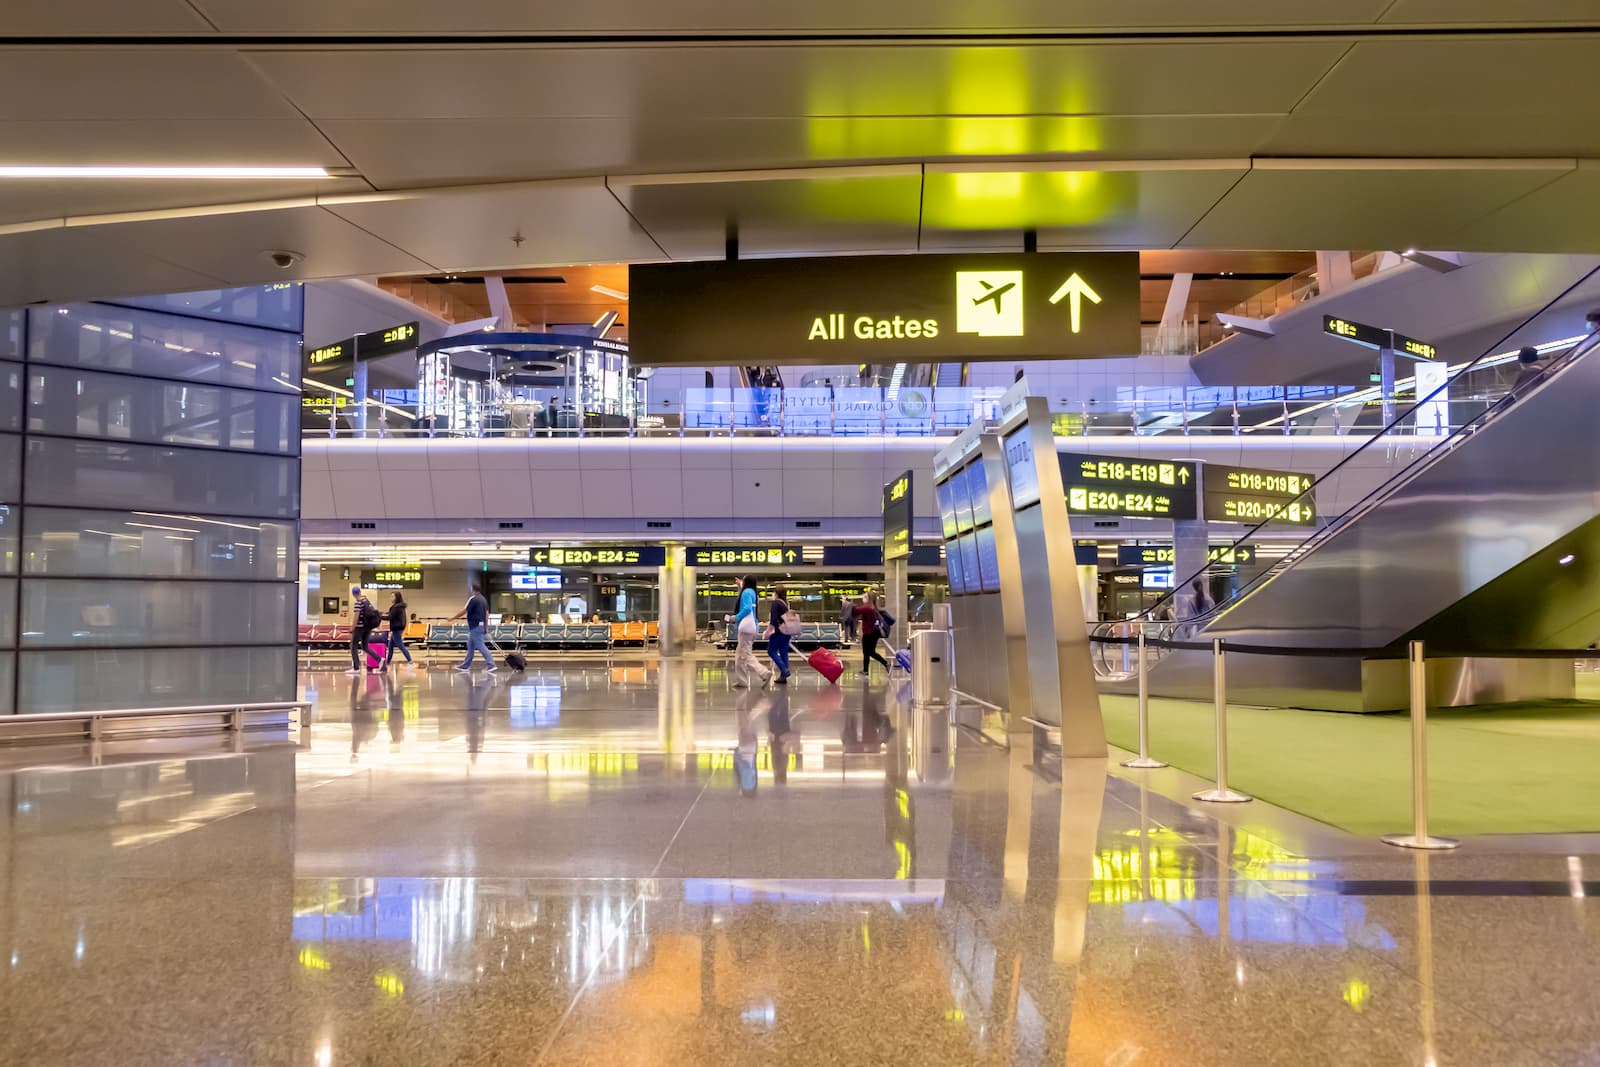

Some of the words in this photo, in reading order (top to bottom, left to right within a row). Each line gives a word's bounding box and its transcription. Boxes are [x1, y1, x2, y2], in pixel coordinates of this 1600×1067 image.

[391, 330, 398, 341] D
[808, 313, 845, 341] All
[853, 315, 939, 341] Gates
[322, 347, 335, 361] ABC
[1098, 462, 1157, 482] E18-E19
[1240, 473, 1287, 492] D18-D19
[1088, 492, 1153, 512] E20-E24
[1237, 501, 1287, 519] D20-D24
[565, 550, 624, 563] E20-E24
[711, 550, 766, 563] E18-E19
